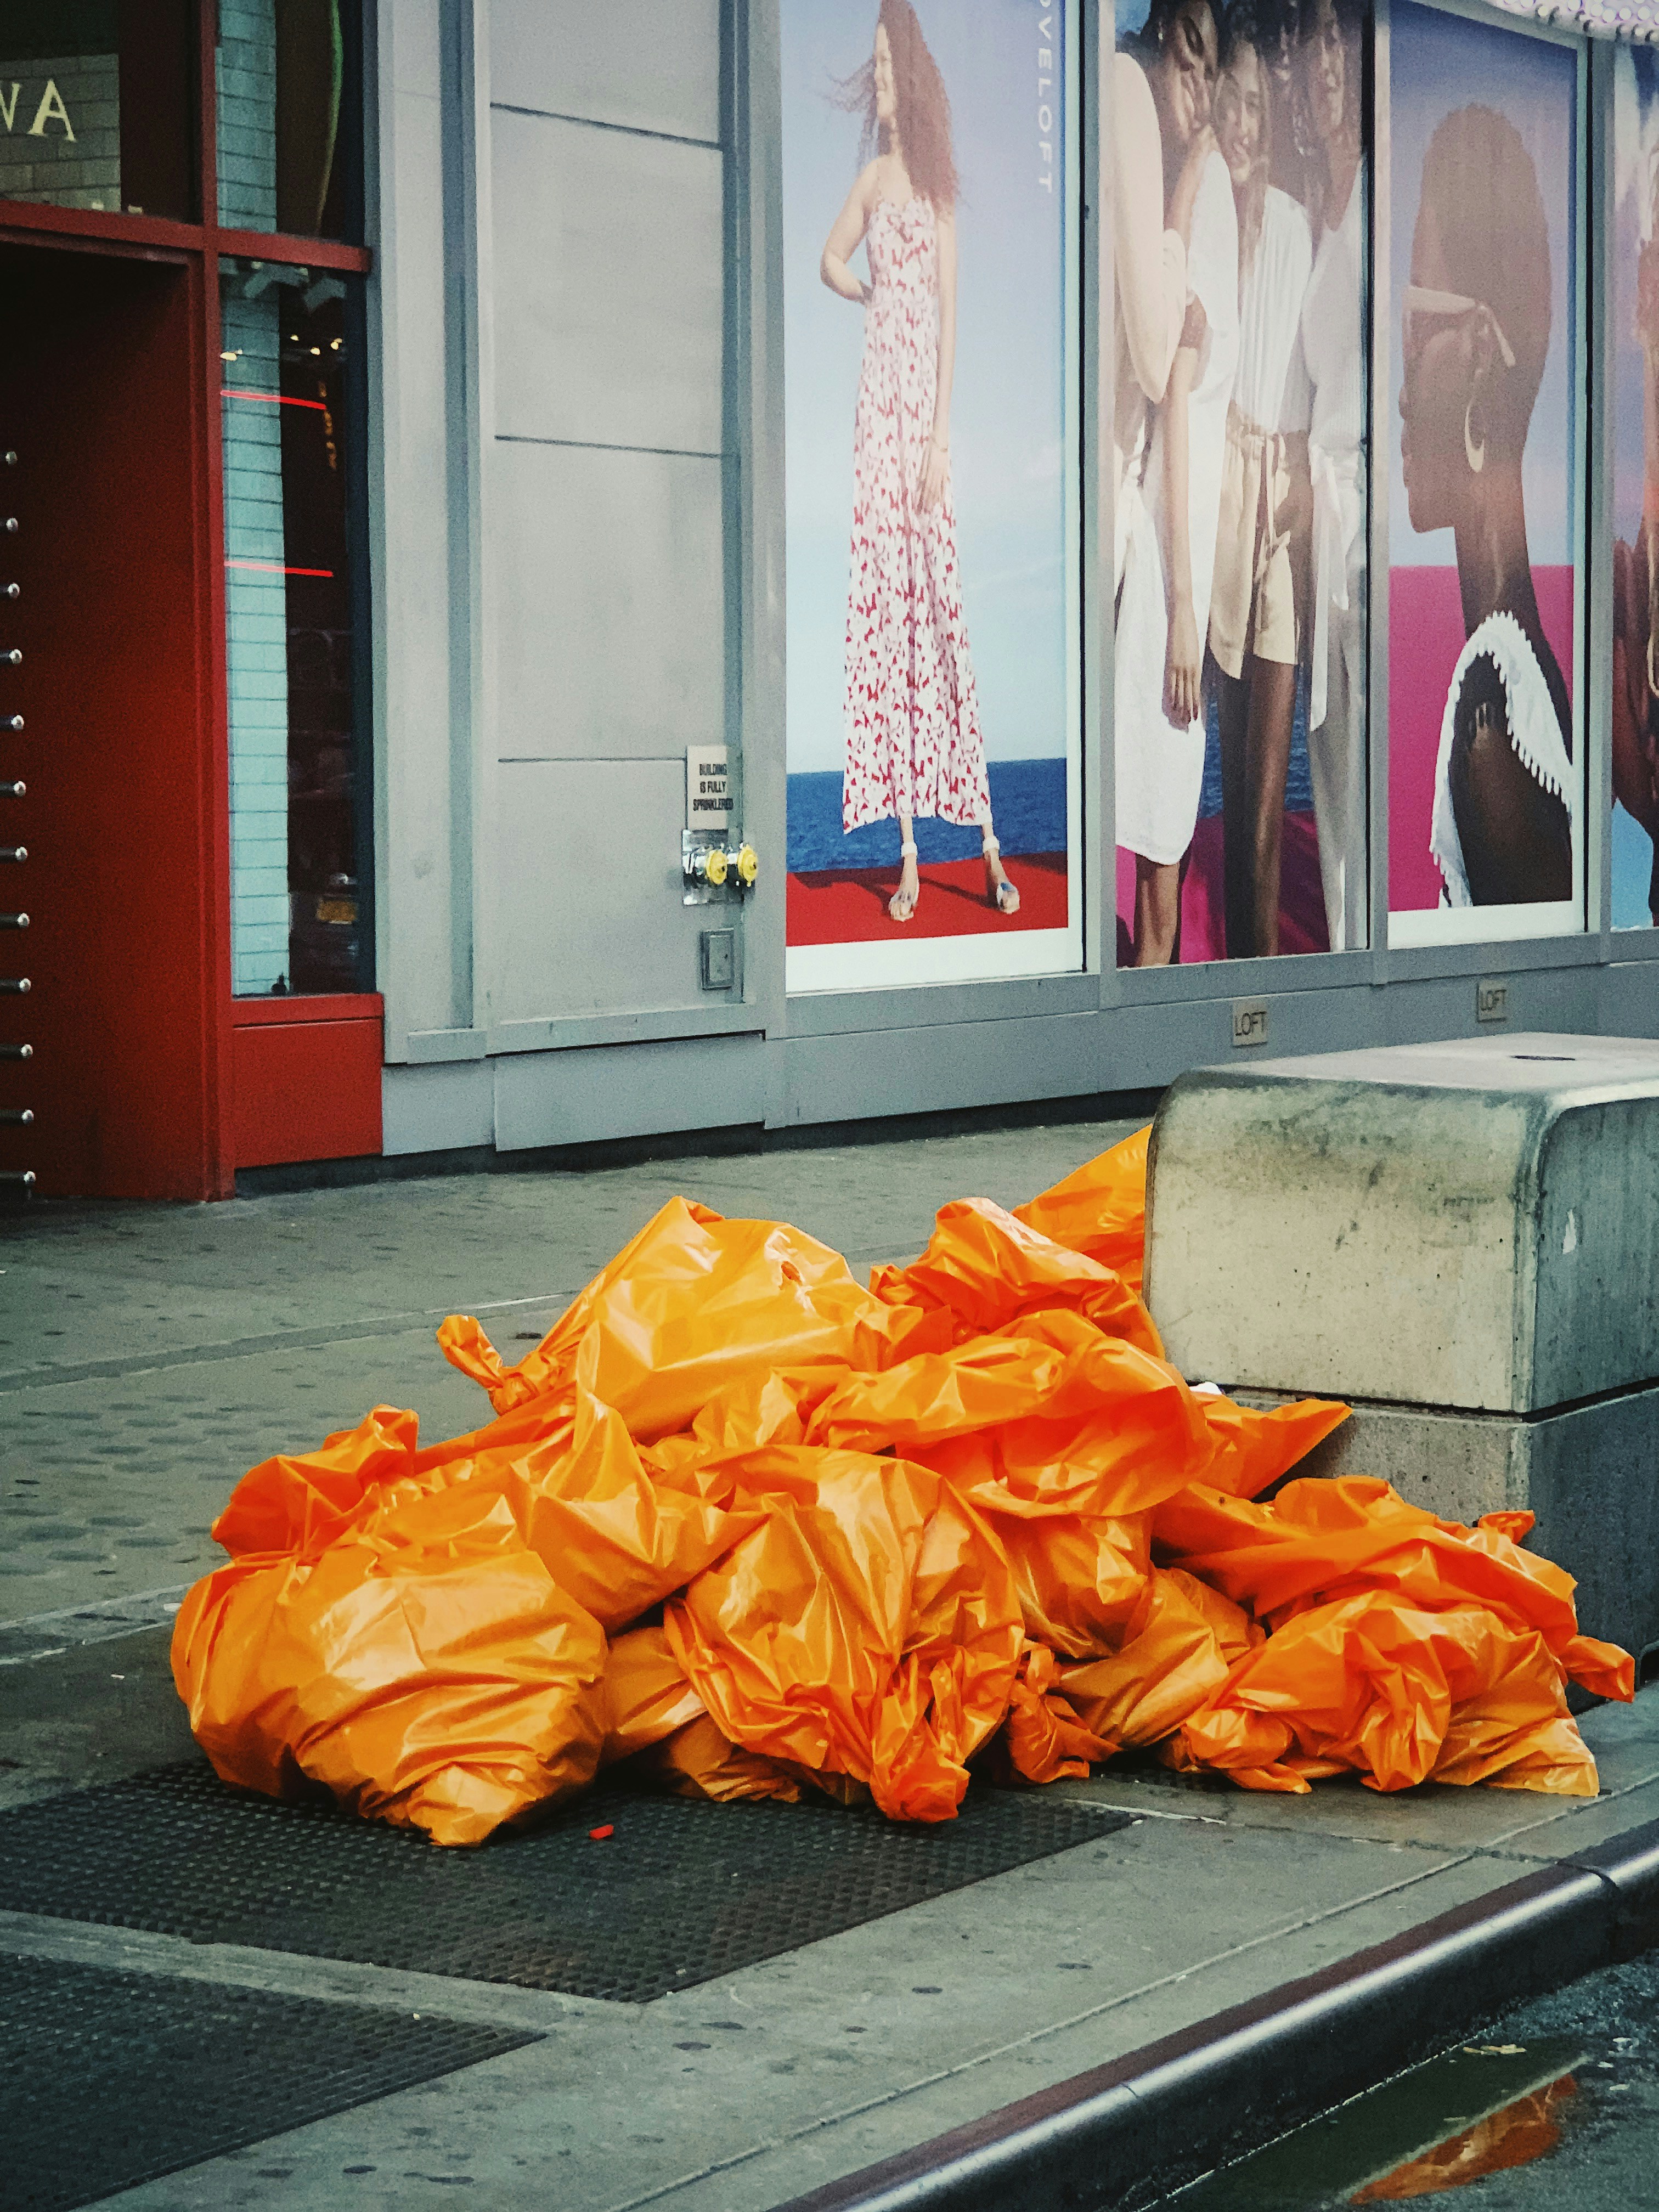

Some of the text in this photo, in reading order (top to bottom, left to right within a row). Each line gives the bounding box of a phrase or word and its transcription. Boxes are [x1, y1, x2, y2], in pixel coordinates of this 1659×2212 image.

[1039, 0, 1052, 194] VELOFT
[699, 763, 727, 776] BUILDING
[700, 781, 726, 793] IS FULLY
[1480, 989, 1506, 1011] LOFT
[1235, 1011, 1267, 1036] LOFT
